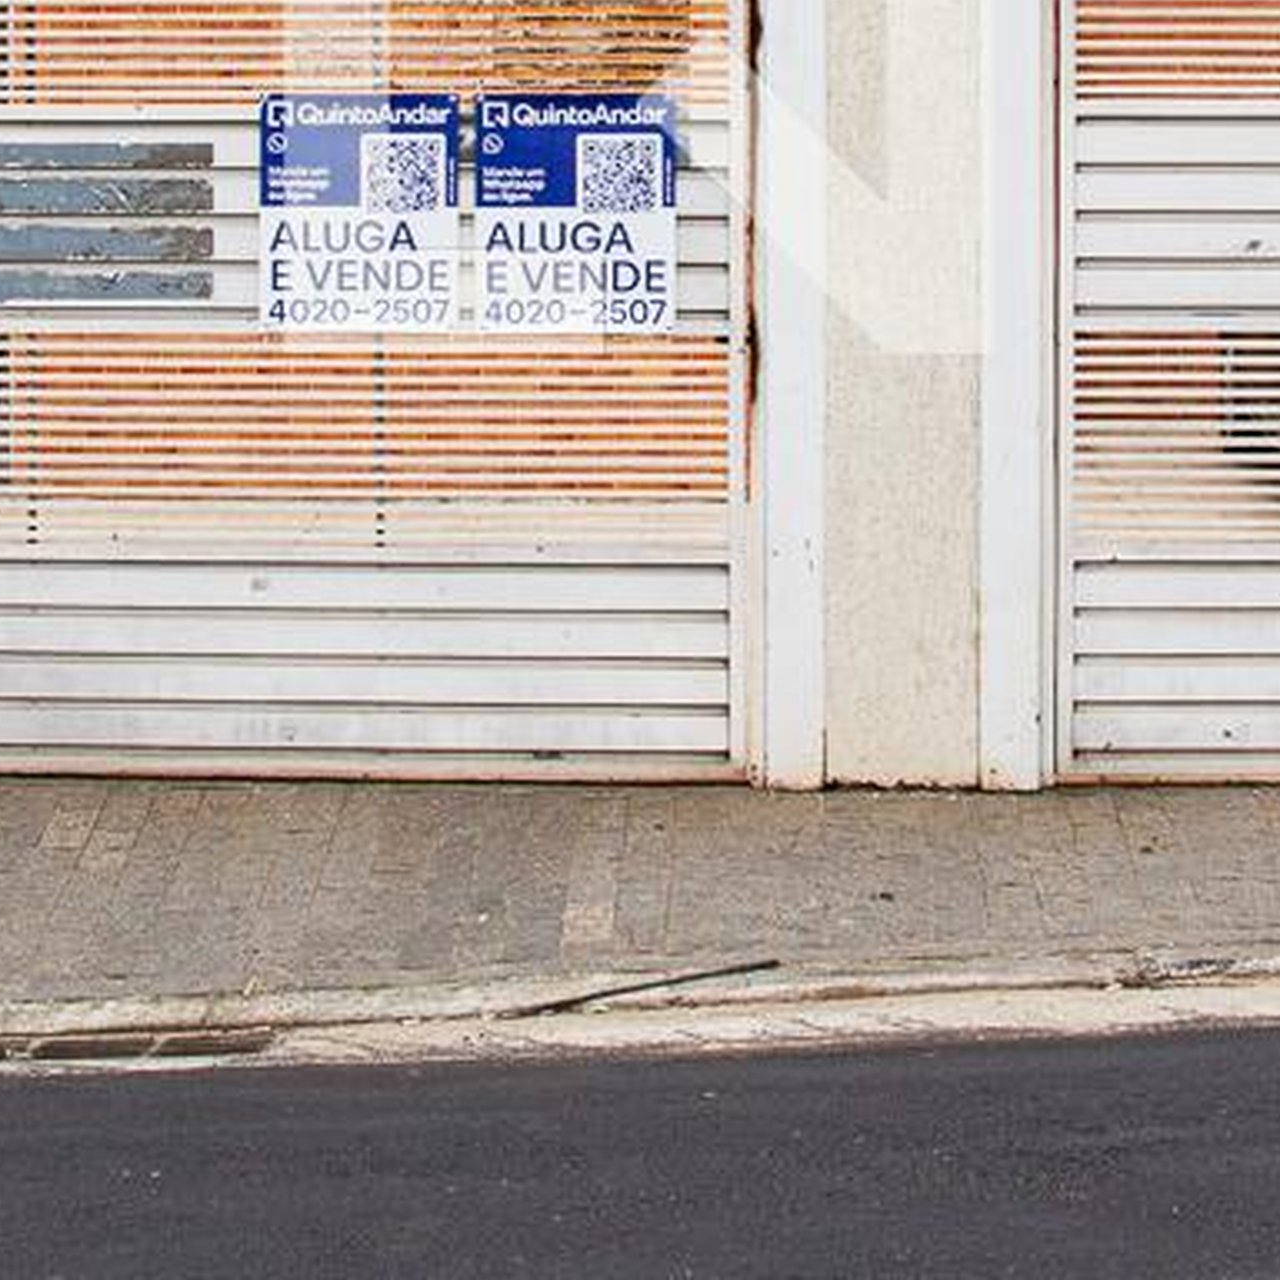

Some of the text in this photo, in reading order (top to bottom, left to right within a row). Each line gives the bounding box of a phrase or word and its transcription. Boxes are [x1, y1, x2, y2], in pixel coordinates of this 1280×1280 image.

[297, 102, 451, 125] QuintoAndar
[513, 102, 667, 125] QuintoAndar
[270, 220, 417, 252] ALUGA
[486, 221, 634, 253] ALUGA
[272, 259, 450, 291] E VENDE
[486, 260, 667, 293] E VENDE
[269, 299, 450, 324] 4020-2507
[485, 299, 668, 325] 4020-2507
